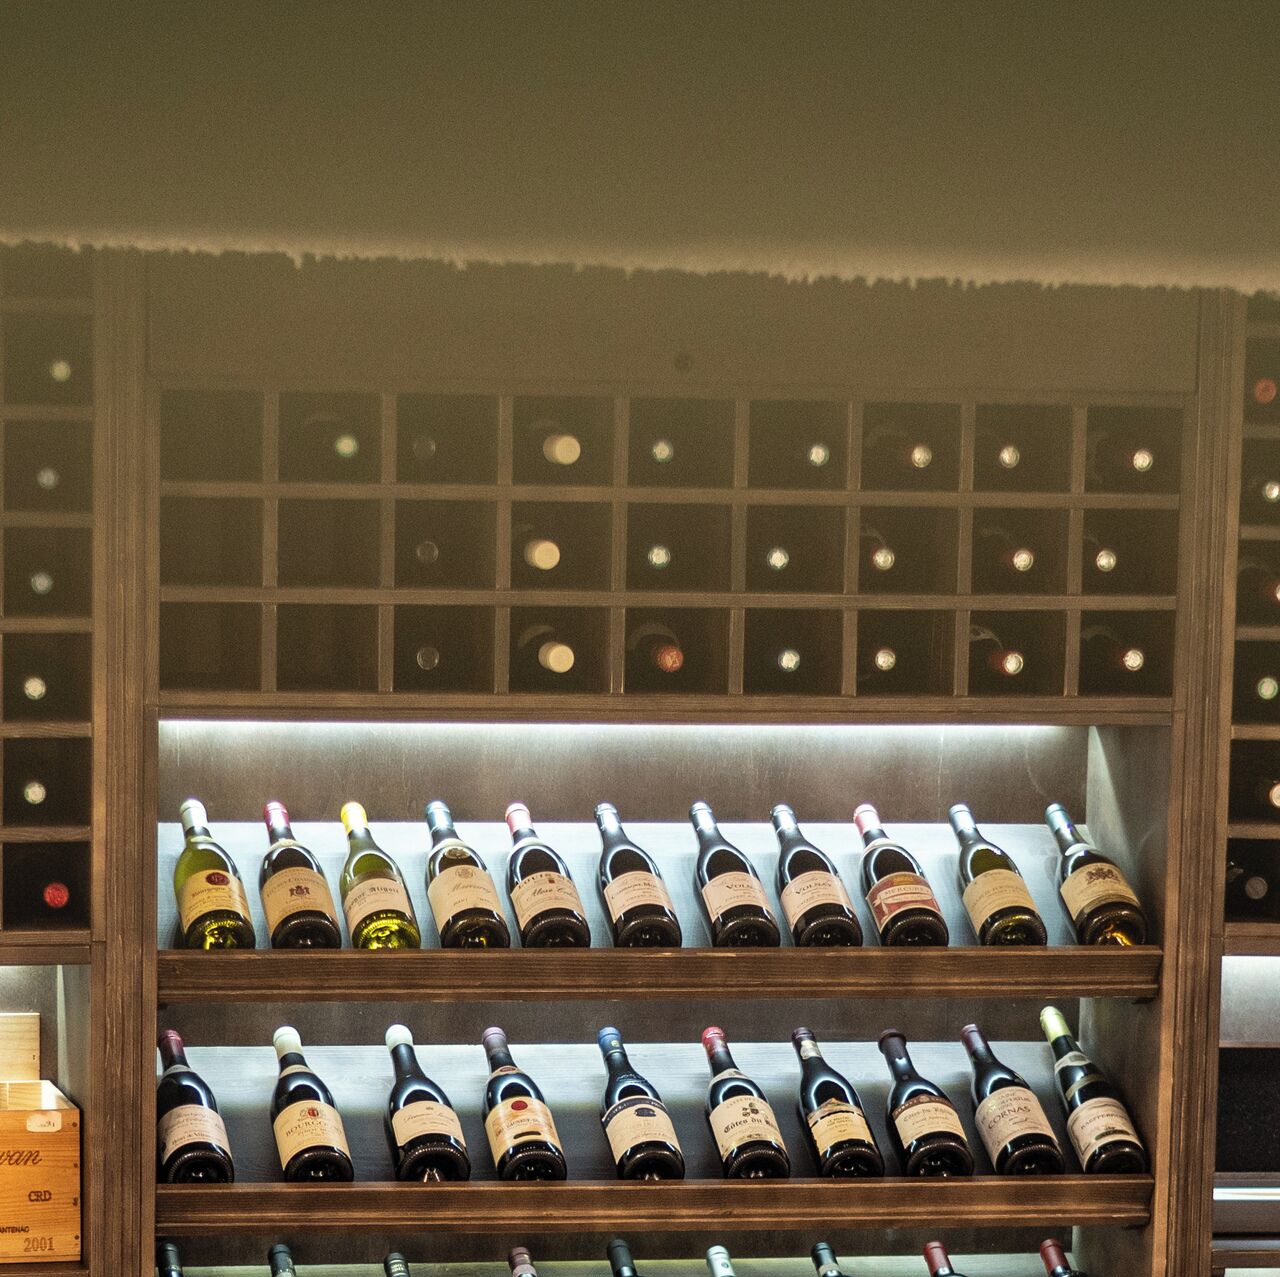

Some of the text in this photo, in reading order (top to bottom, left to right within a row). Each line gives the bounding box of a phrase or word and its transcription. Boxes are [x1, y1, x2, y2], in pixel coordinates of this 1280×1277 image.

[795, 882, 832, 895] VOLNAY
[988, 1105, 1031, 1129] CORNAS
[286, 1121, 342, 1137] BOURGO
[724, 1119, 748, 1133] Côtes
[28, 1190, 52, 1202] CRD
[23, 1237, 55, 1251] 2001
